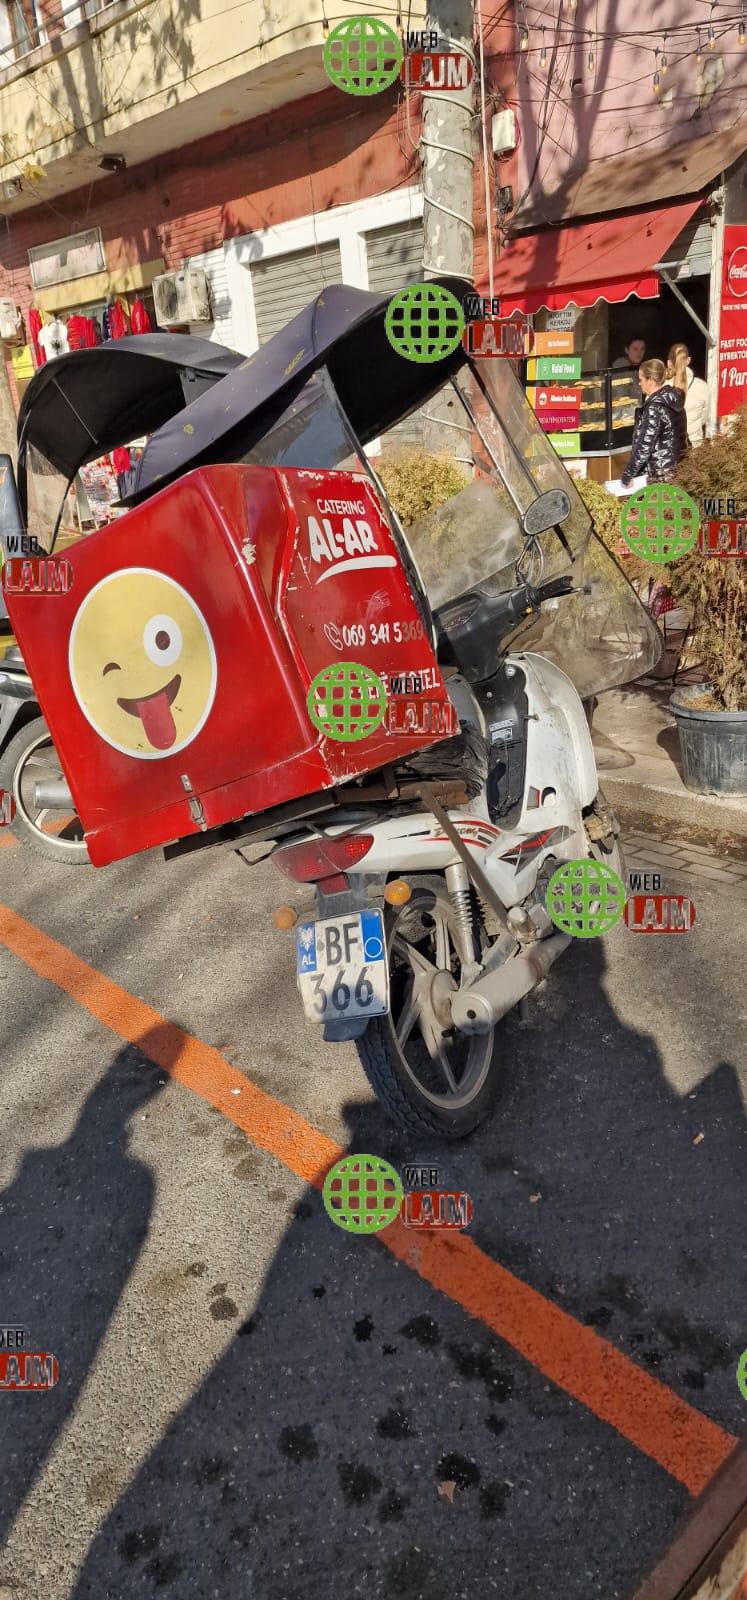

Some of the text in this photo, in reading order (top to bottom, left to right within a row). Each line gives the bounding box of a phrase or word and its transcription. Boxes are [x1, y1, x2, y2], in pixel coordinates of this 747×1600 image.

[720, 339, 735, 349] FAST
[317, 499, 365, 515] CATERING
[343, 624, 366, 647] 069
[370, 623, 390, 645] 341
[325, 922, 359, 966] BF
[301, 954, 315, 966] AL
[310, 967, 374, 1014] 366
